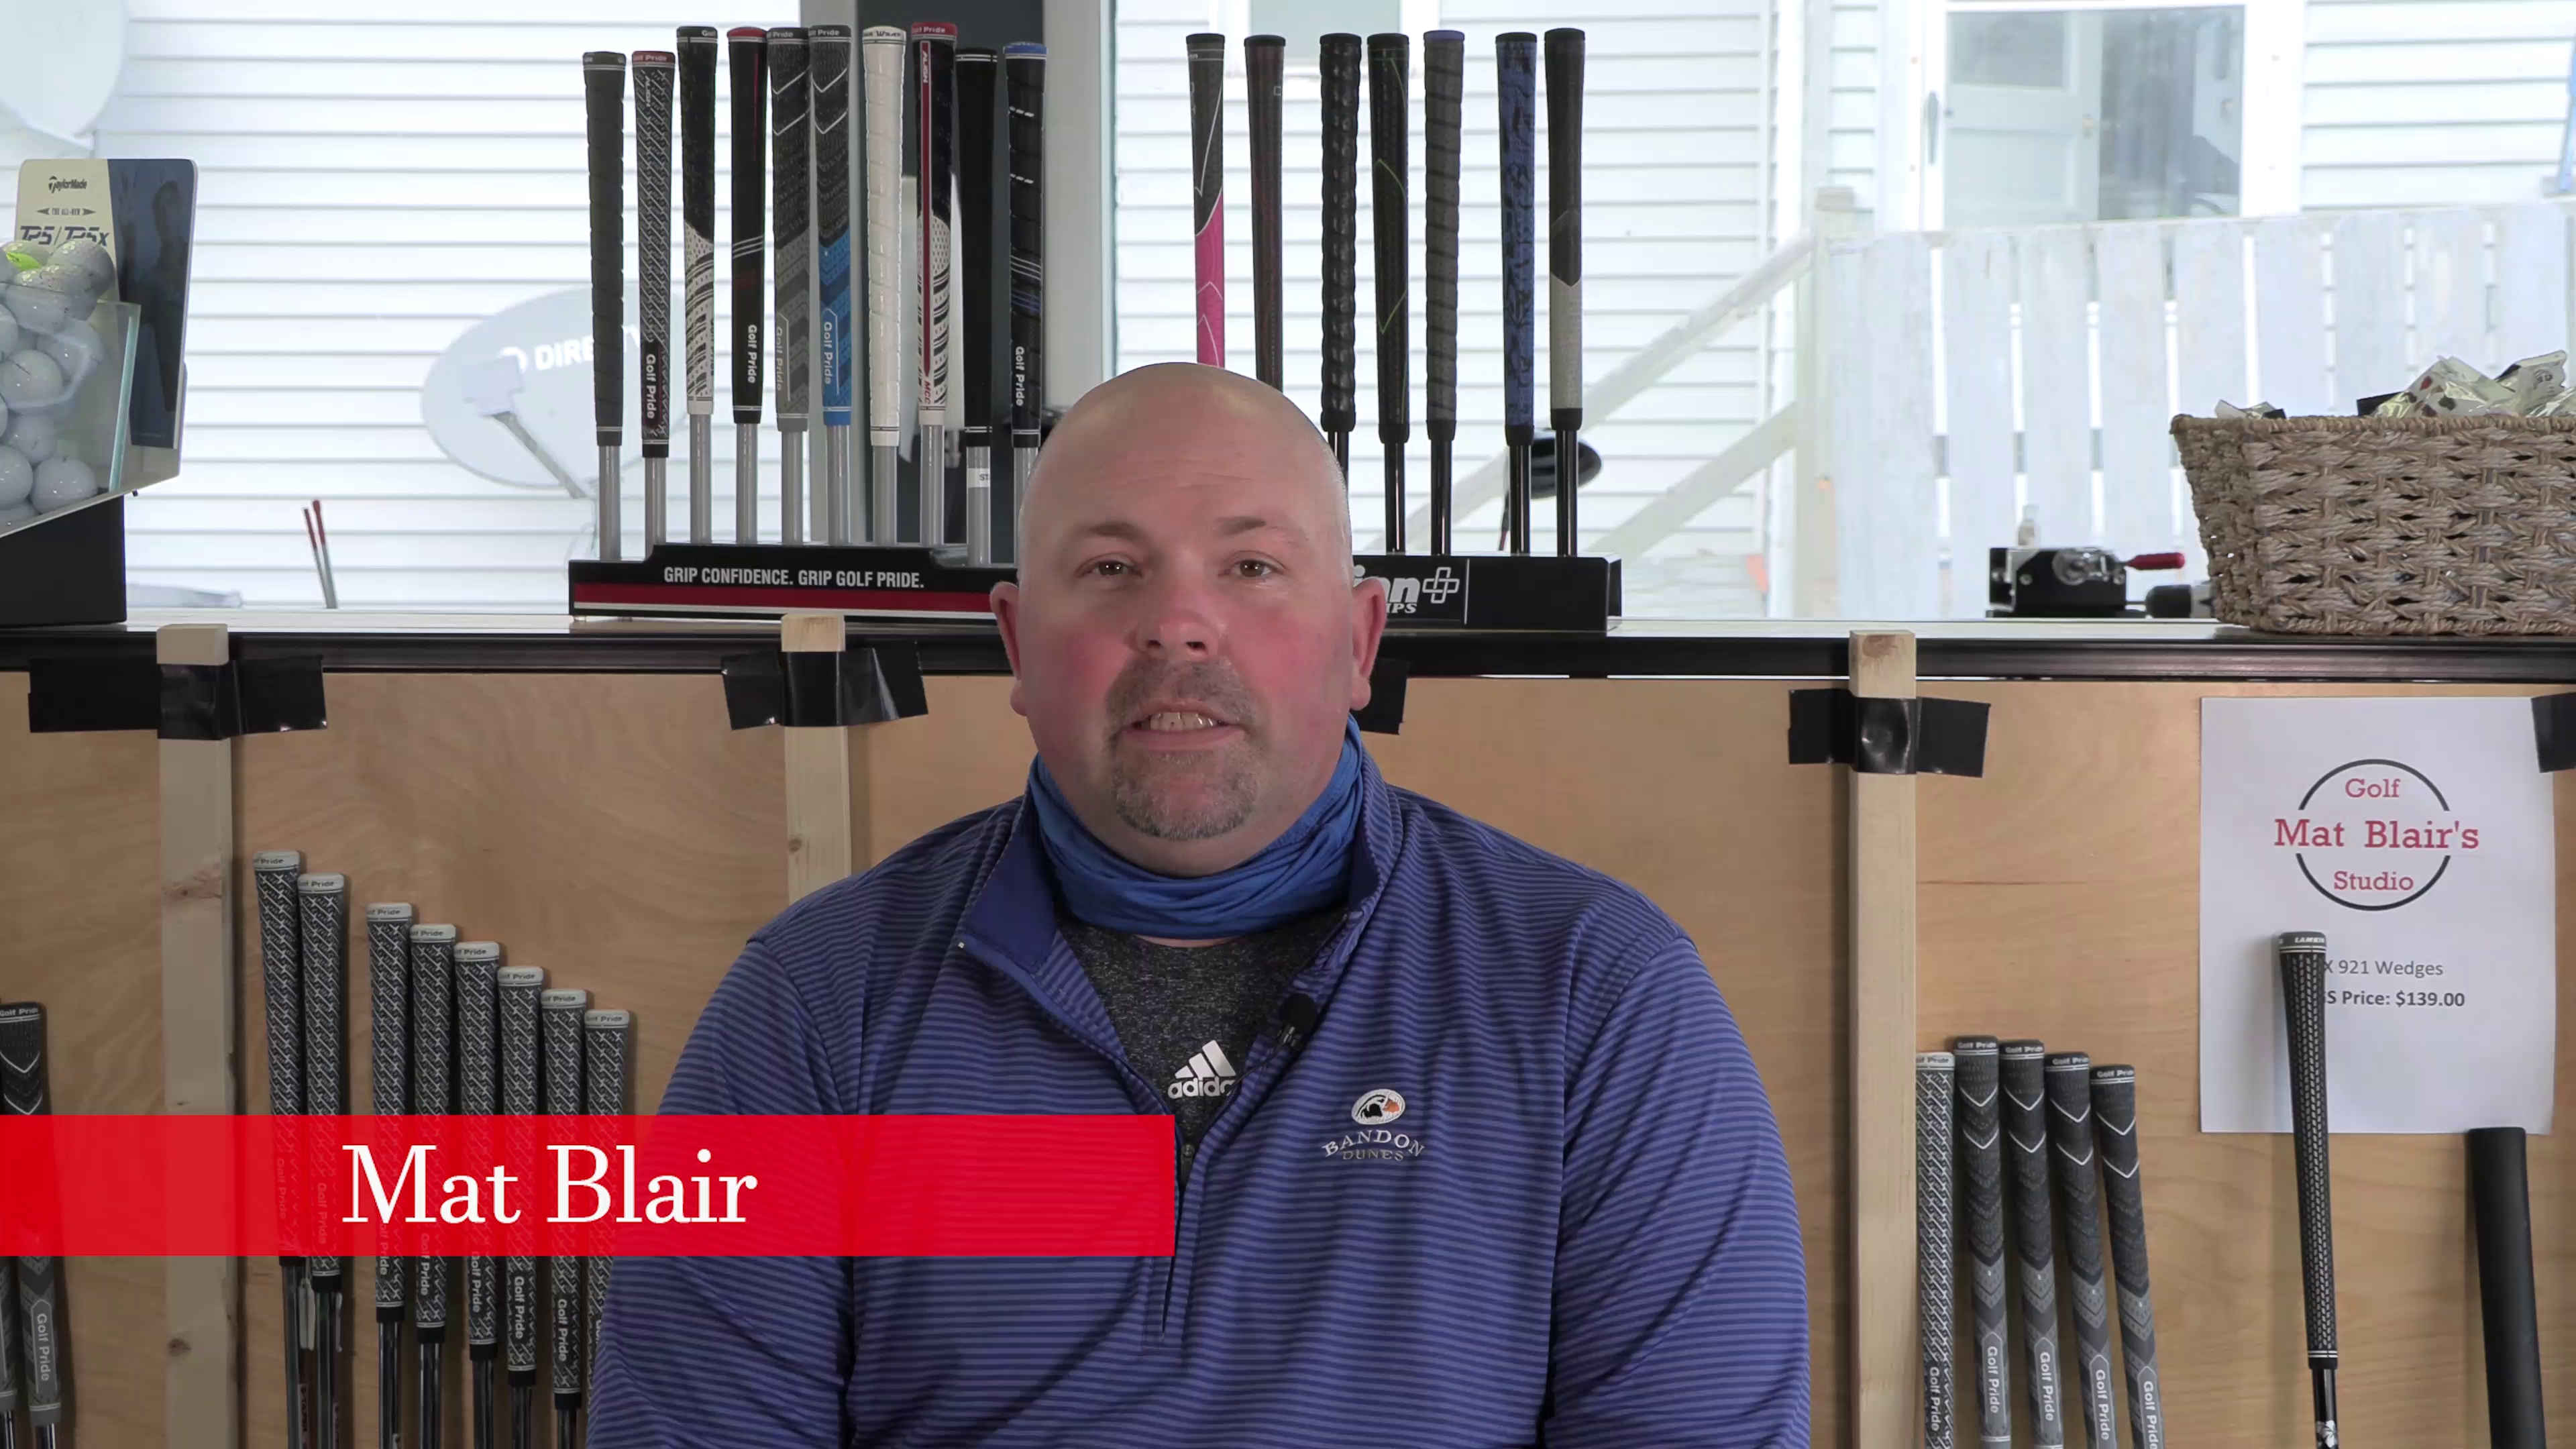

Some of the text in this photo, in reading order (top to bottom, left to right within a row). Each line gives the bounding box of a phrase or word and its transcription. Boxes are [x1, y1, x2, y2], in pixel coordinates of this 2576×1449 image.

[48, 176, 87, 193] TaylorMade
[747, 324, 757, 384] Golf Pride
[824, 322, 833, 384] Golf Pride
[1016, 346, 1025, 406] Golf Pride
[646, 354, 657, 419] Golf Pride
[664, 567, 924, 588] GRIP CONFIDENCE. GRIP GOLF PRIDE.
[2345, 777, 2401, 798] Golf
[2274, 818, 2479, 849] Mat Blair's
[2333, 870, 2414, 891] Studio
[2339, 960, 2369, 975] 921
[2375, 961, 2444, 978] Wedges
[2342, 991, 2390, 1006] Price:
[2396, 990, 2465, 1008] $139.00
[2052, 1057, 2070, 1065] Golf
[1322, 1129, 1425, 1158] BANDON
[1342, 1148, 1404, 1163] DUNES
[380, 1242, 389, 1275] Pride
[421, 1233, 430, 1296] Golf Pride
[472, 1250, 482, 1313] Golf Pride
[515, 1276, 526, 1340] Golf Pride
[557, 1299, 569, 1362] Golf Pride
[37, 1313, 51, 1381] Golf Pride
[1929, 1366, 1941, 1432] Golf Pride
[1987, 1346, 2000, 1413] Golf Pride
[2039, 1352, 2055, 1421] Golf Pride
[2096, 1369, 2111, 1440] Golf Pride
[2143, 1381, 2159, 1449] Golf Pride
